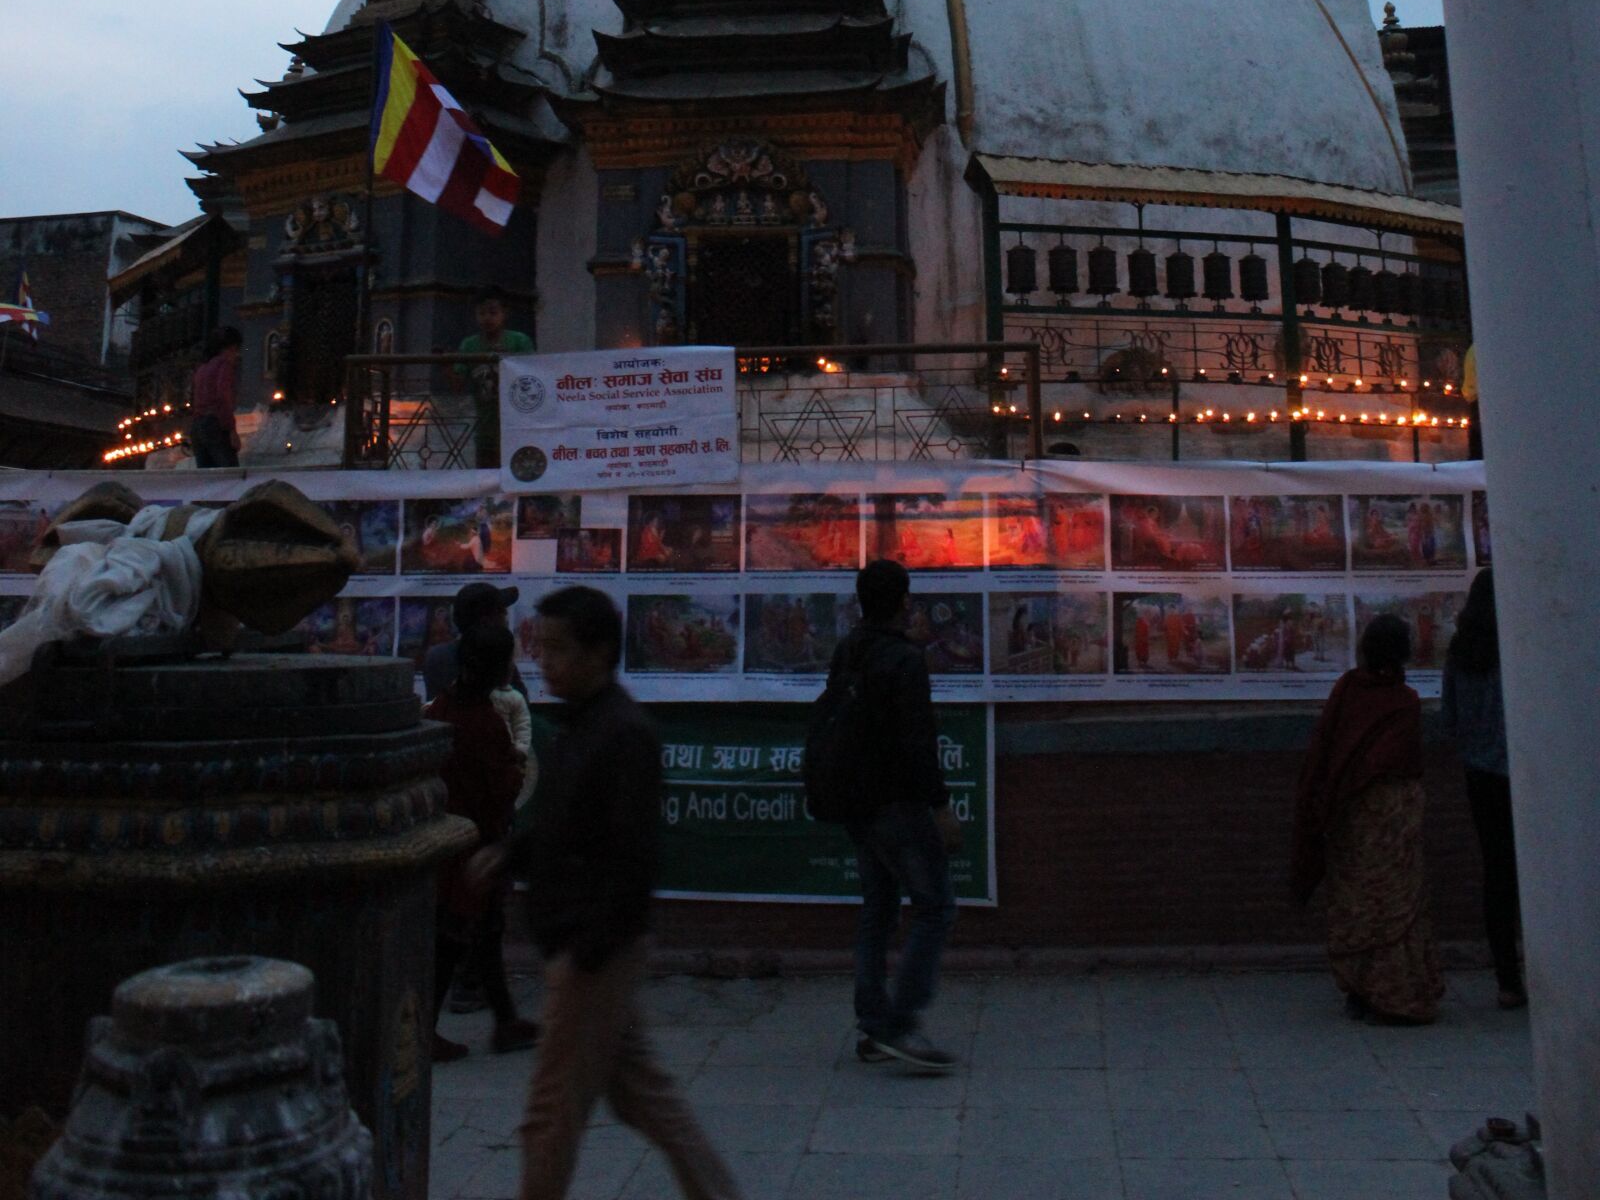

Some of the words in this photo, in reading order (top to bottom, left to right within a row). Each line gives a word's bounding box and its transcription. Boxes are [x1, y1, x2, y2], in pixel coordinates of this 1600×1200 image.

[603, 373, 653, 389] समाज
[658, 369, 689, 386] सेवा
[695, 367, 723, 384] संघ
[556, 392, 586, 403] Neela
[589, 390, 620, 401] Social
[622, 388, 661, 399] Service
[664, 385, 723, 396] Association
[610, 446, 630, 459] तथा
[658, 439, 698, 456] सहकारी
[660, 744, 705, 769] तथा
[711, 745, 761, 770] ऋण
[685, 791, 728, 820] And
[733, 791, 797, 821] Credit
[948, 792, 976, 822] td.
